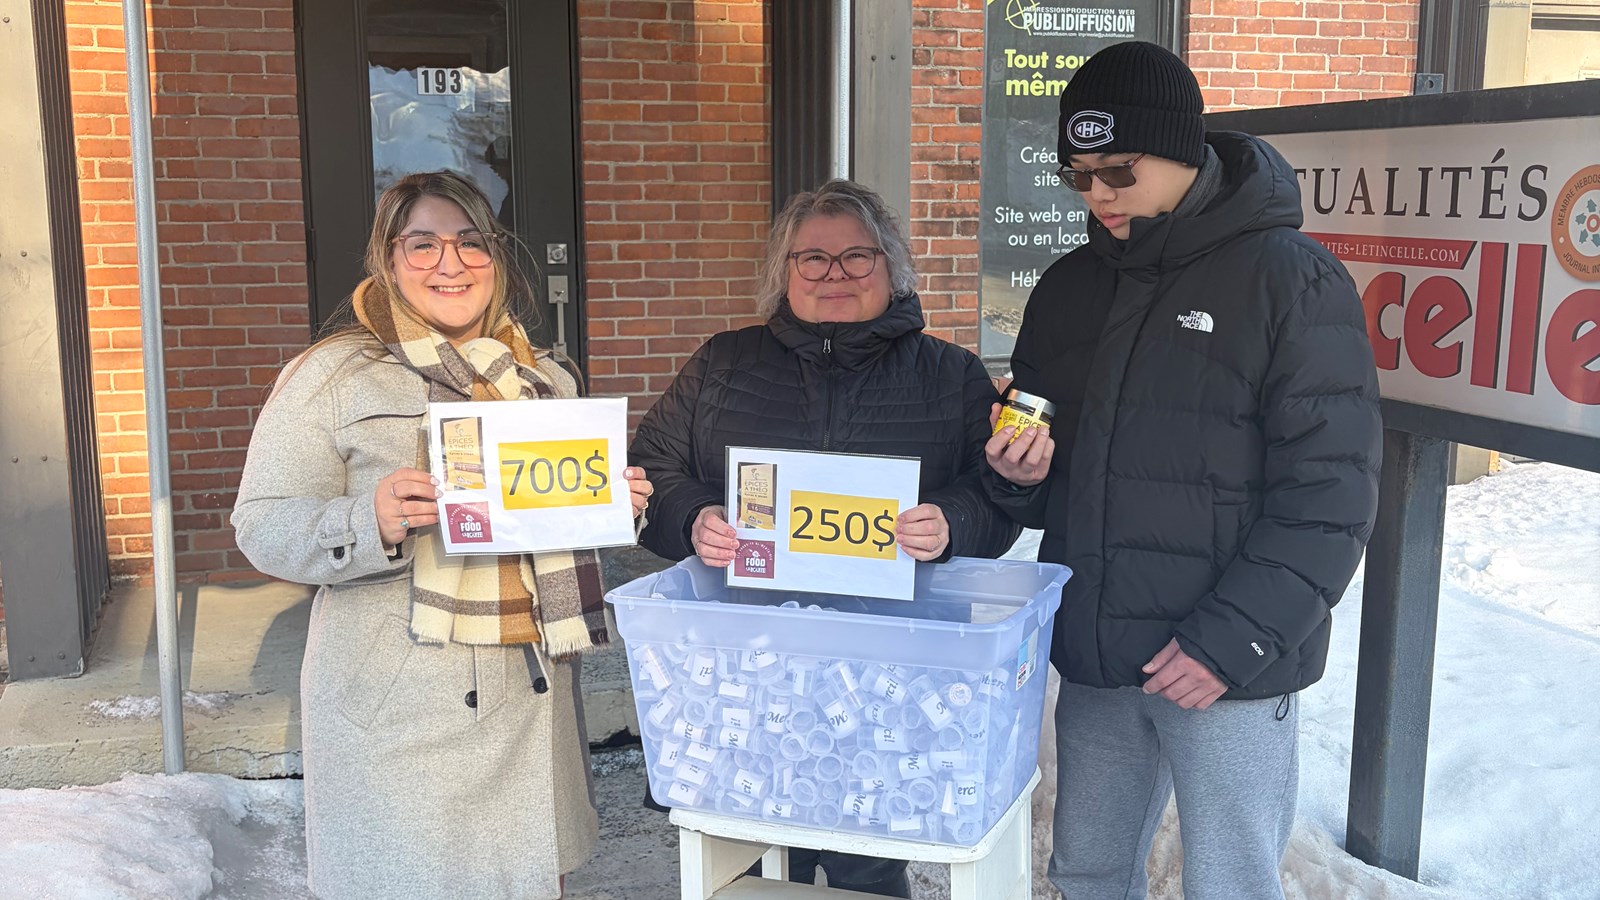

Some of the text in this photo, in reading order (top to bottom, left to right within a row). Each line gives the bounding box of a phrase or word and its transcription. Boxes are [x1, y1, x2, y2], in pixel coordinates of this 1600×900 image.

[1023, 13, 1135, 33] PUBLIDIFFUSION
[1005, 49, 1049, 70] Tout
[421, 69, 462, 94] 193
[1034, 171, 1060, 187] site
[994, 204, 1085, 224] Site web en
[1558, 189, 1576, 226] MEMBRE
[1008, 226, 1090, 246] ou en loca
[1321, 241, 1460, 263] ITES-LETINCELLE.COM
[1563, 251, 1590, 274] JOURNAL
[1176, 314, 1201, 326] NORTH
[1190, 310, 1203, 318] THE
[1181, 320, 1199, 330] FACE
[501, 450, 608, 497] 700$
[460, 522, 482, 532] FOOD
[791, 506, 895, 552] 250$
[745, 557, 766, 567] FOOD
